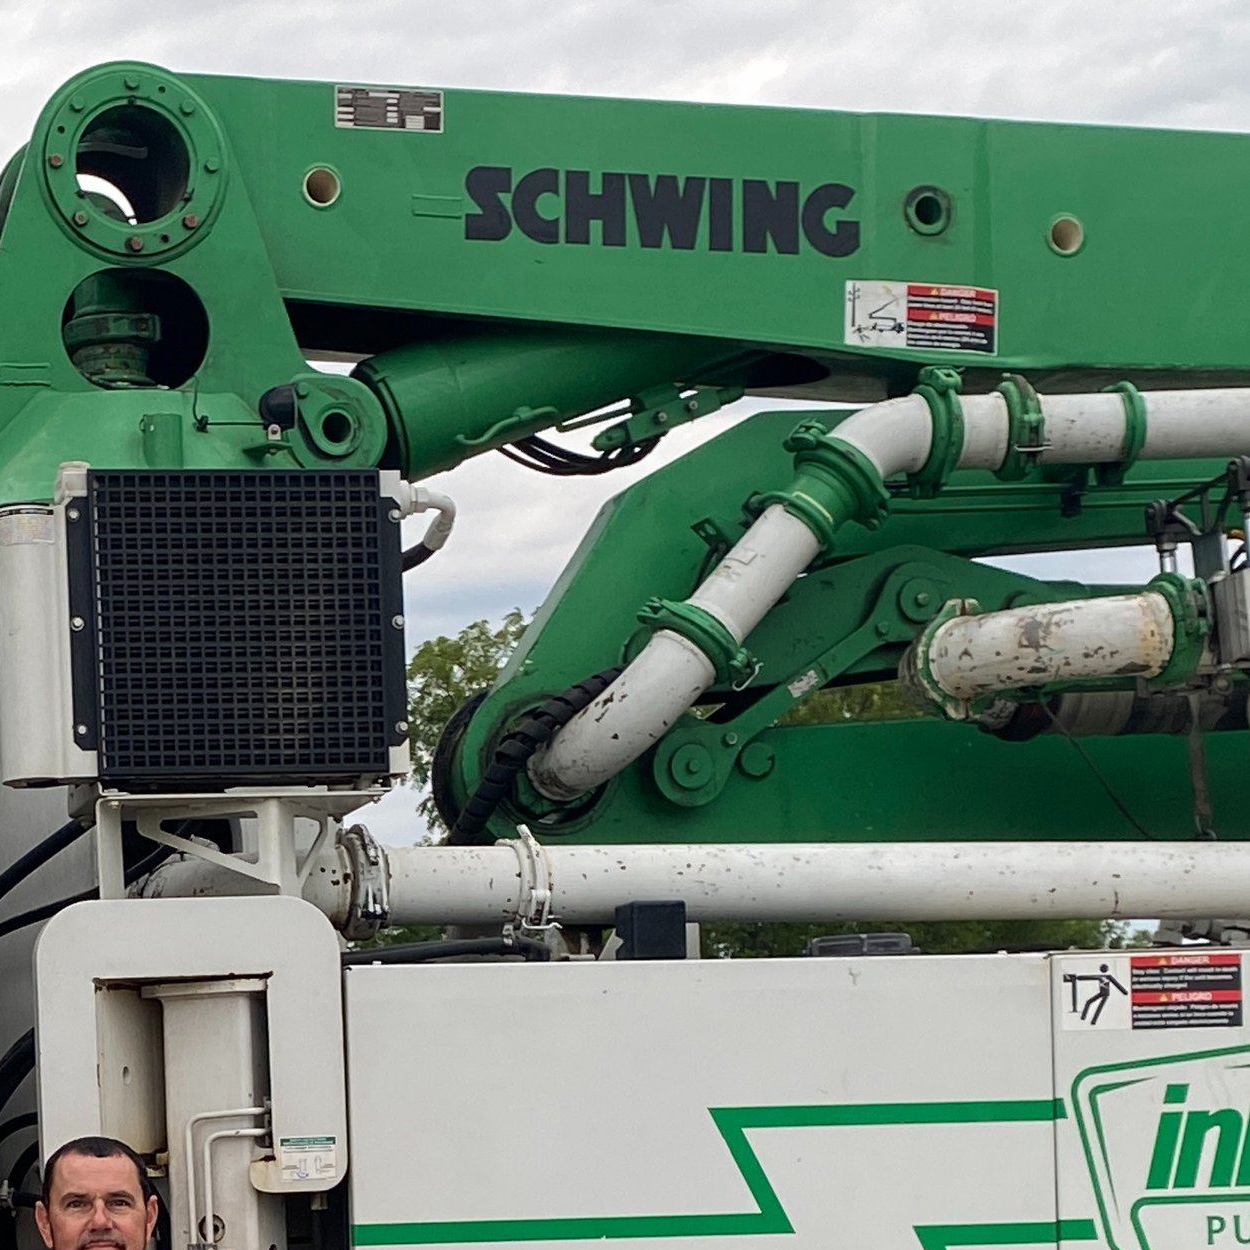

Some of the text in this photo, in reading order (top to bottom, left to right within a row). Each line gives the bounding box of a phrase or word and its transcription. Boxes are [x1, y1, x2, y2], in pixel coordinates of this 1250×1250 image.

[464, 165, 861, 258] SCHWING
[1170, 956, 1210, 965] DANGER
[1171, 992, 1213, 1002] PELIGRO
[1145, 1083, 1250, 1190] in
